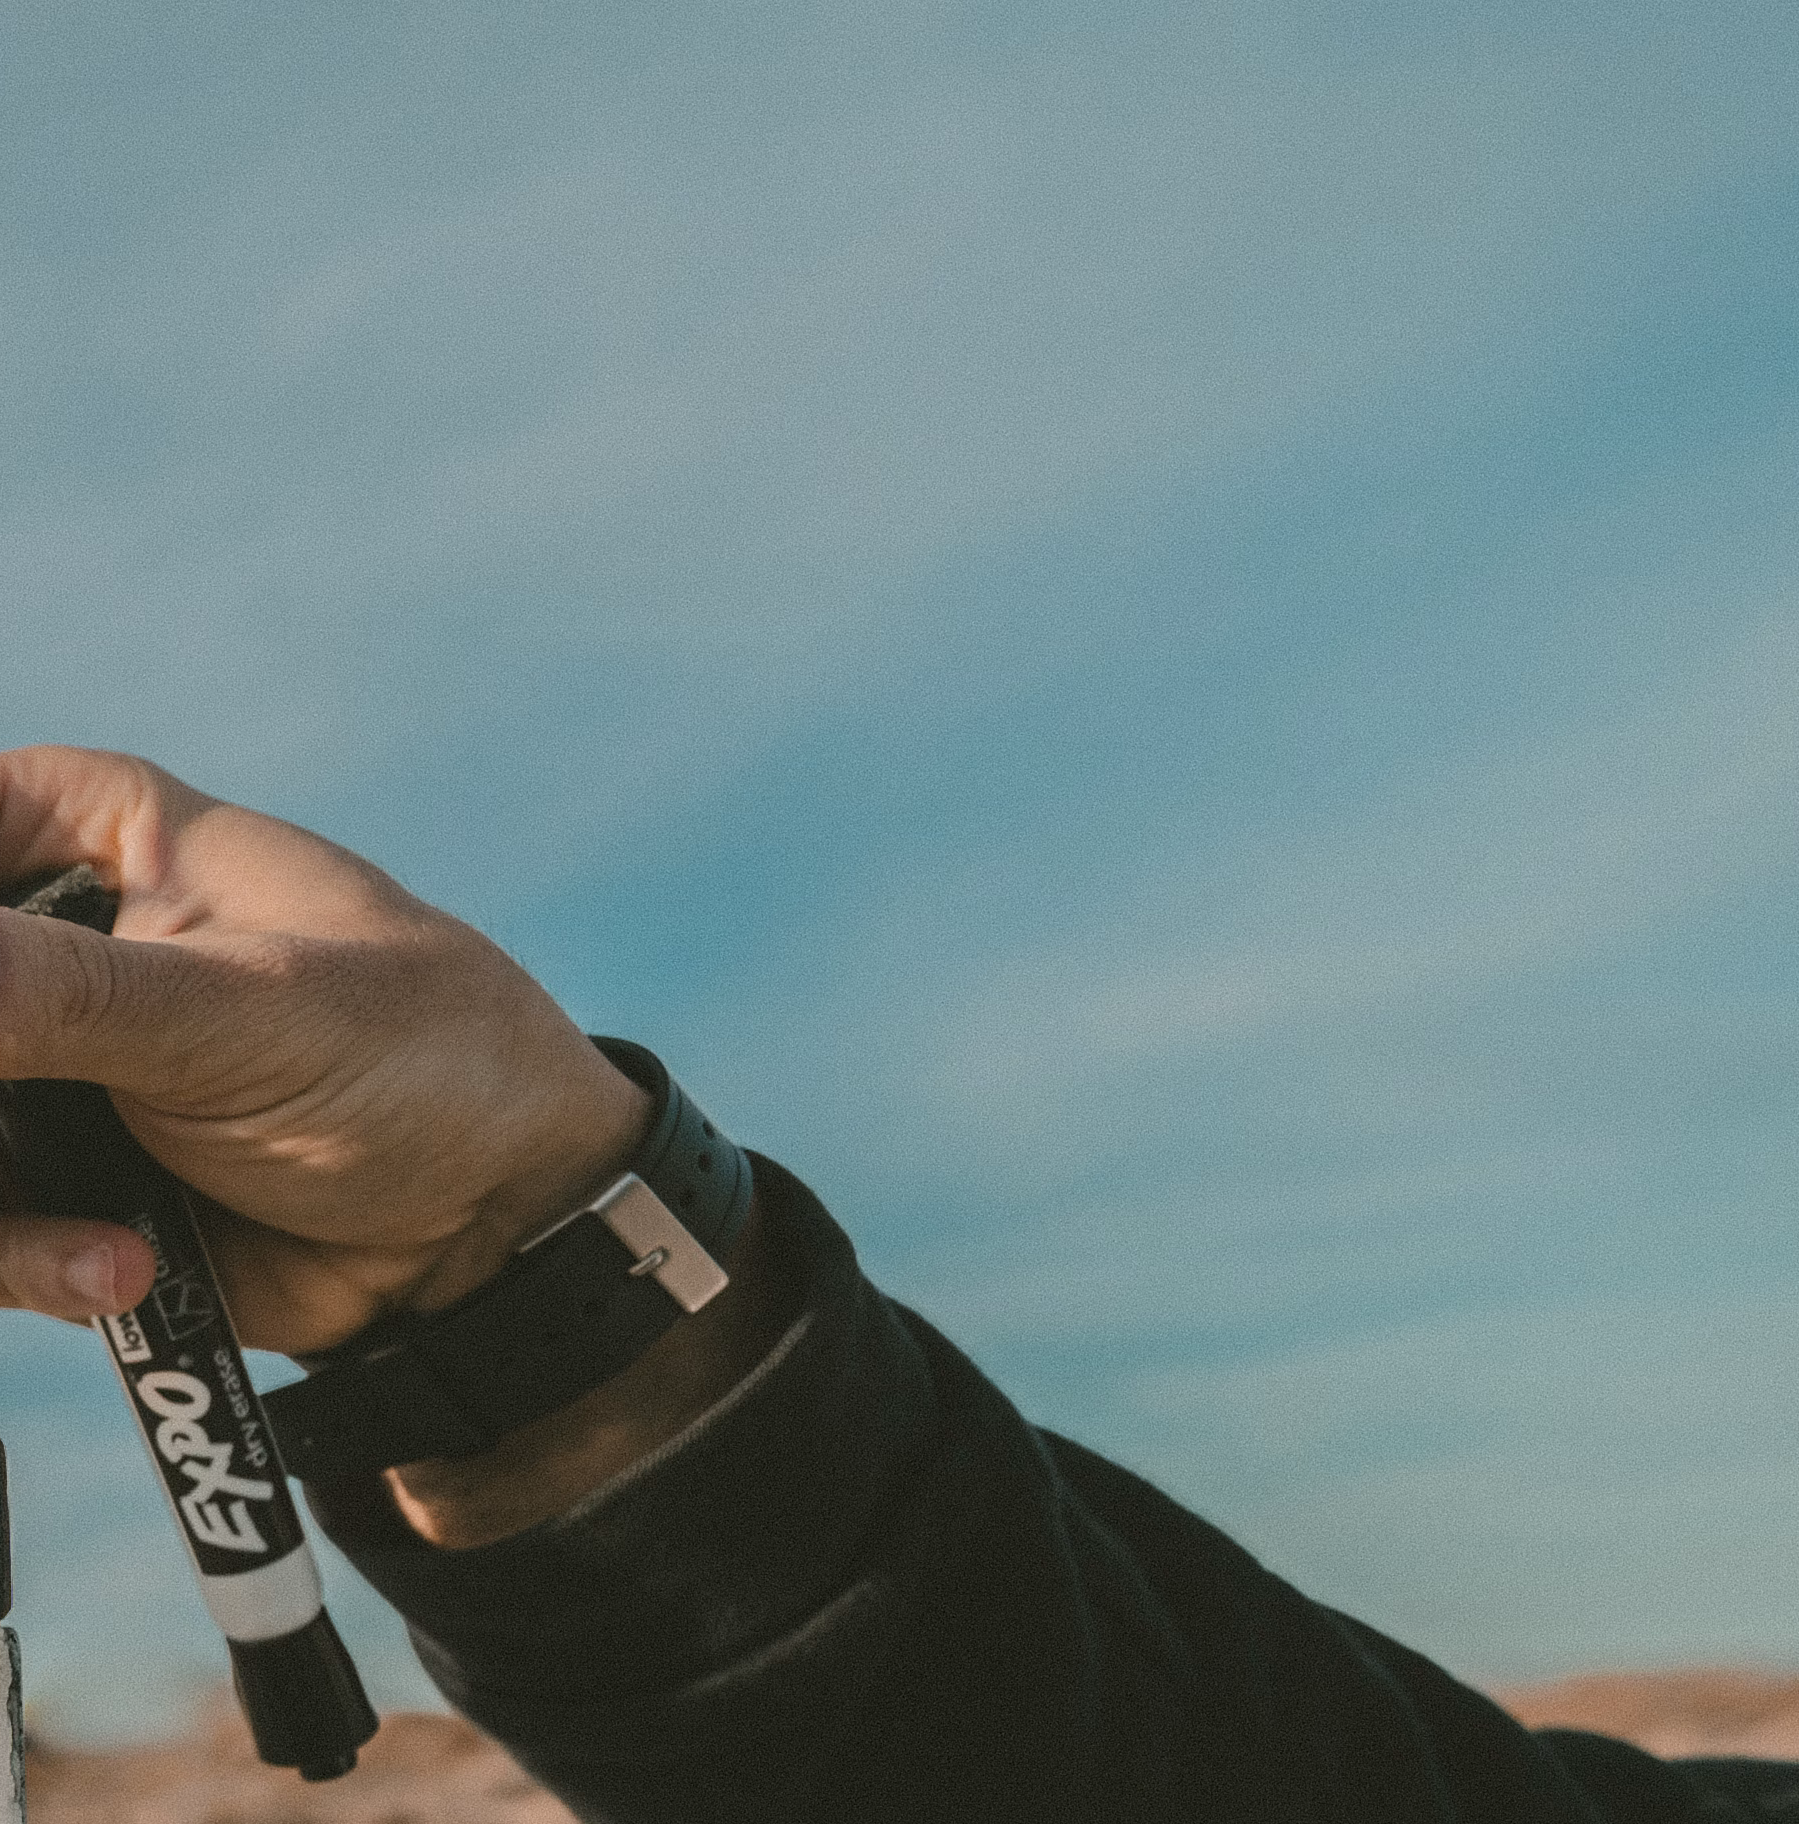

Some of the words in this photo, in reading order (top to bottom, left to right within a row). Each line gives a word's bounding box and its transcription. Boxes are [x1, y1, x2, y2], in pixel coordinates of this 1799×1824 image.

[215, 1349, 250, 1419] erase
[136, 1370, 275, 1554] EXPO
[241, 1421, 268, 1467] dry
